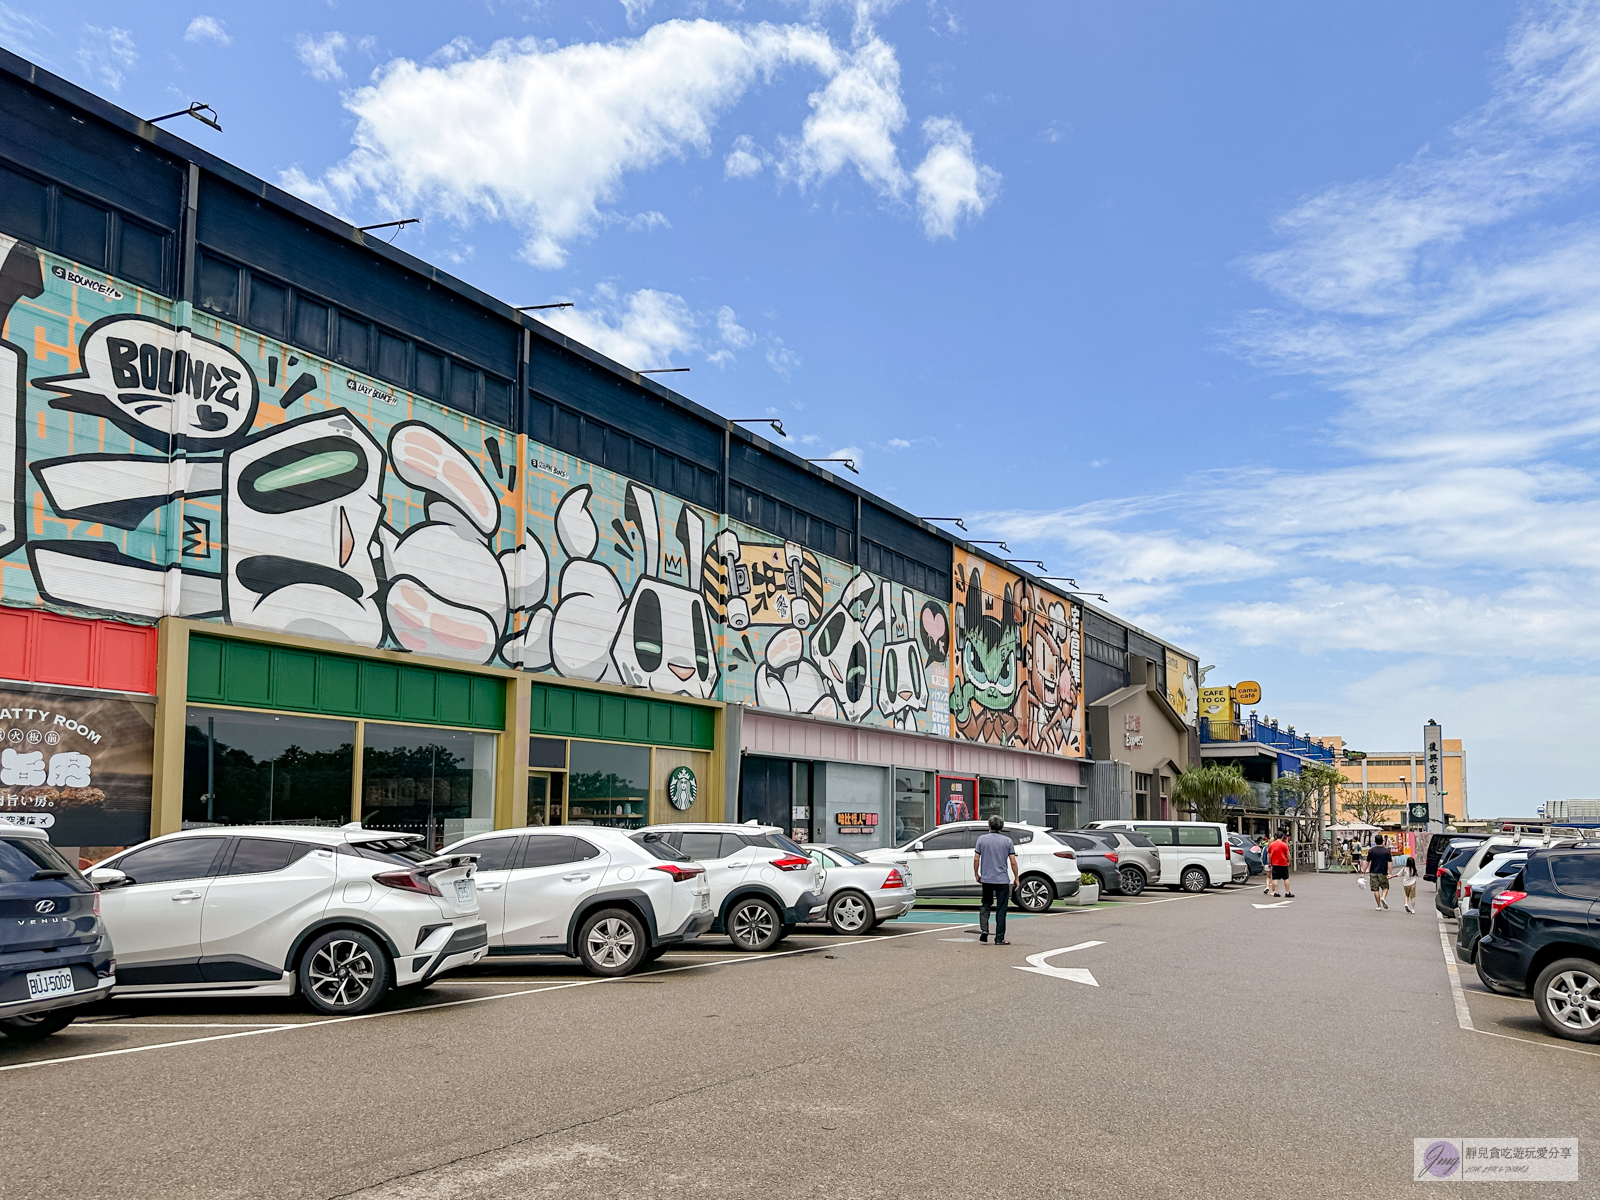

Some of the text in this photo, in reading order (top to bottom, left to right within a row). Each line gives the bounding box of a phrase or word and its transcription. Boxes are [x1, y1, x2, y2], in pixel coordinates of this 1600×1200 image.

[55, 267, 115, 296] 5 BOUNCE!!
[106, 336, 241, 411] BOUNCE
[347, 381, 355, 389] 4
[53, 714, 102, 744] ROOM
[931, 722, 950, 737] ARTS
[0, 815, 36, 825] 空港店
[18, 917, 68, 926] VENUE
[28, 974, 72, 995] BUJ-5009
